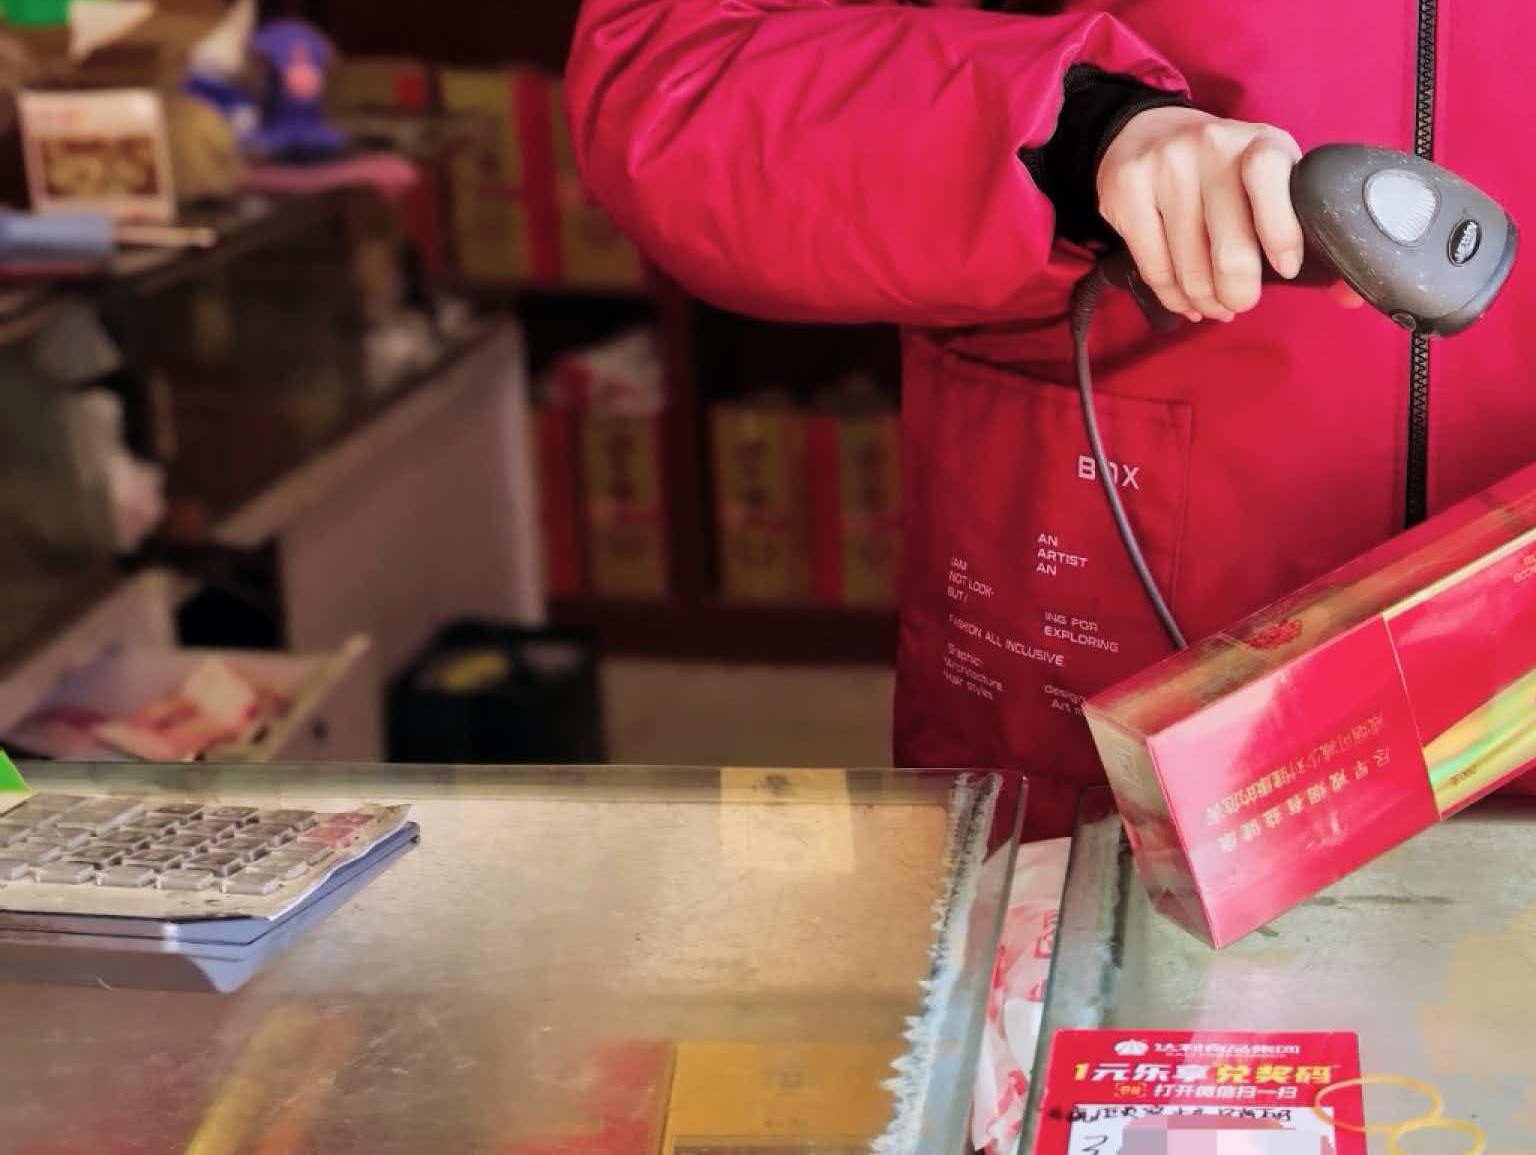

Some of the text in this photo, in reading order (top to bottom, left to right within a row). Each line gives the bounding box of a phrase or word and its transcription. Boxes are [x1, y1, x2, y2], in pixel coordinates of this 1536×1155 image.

[1037, 533, 1058, 546] AN
[1037, 548, 1088, 568] ARTIST
[1036, 563, 1056, 576] AN
[1071, 617, 1098, 633] FOR
[1044, 625, 1120, 653] EXPLORING
[985, 631, 1002, 647] ALL
[1004, 639, 1065, 667] INCLUSIVE
[1216, 746, 1391, 853] 尽早戒烟有益健康
[1153, 1084, 1298, 1099] 打开微信扫一扫
